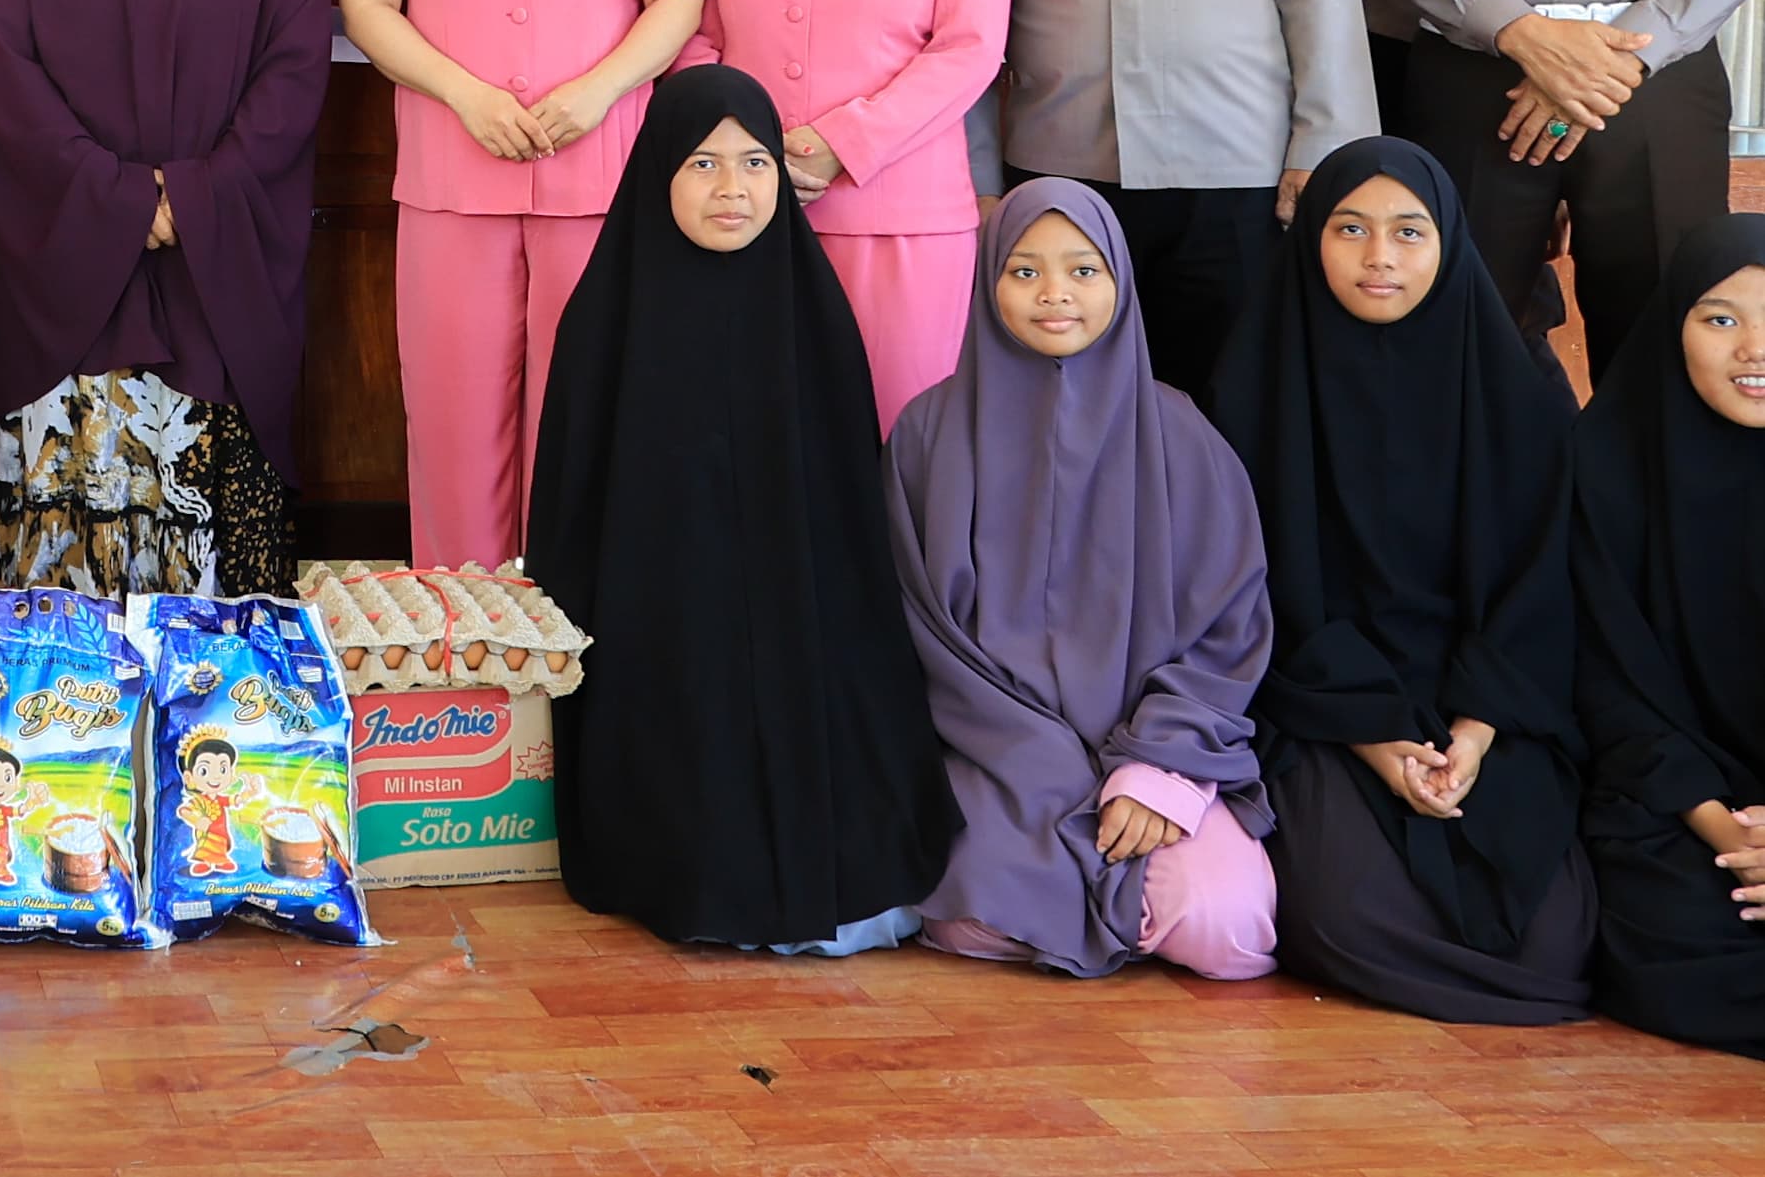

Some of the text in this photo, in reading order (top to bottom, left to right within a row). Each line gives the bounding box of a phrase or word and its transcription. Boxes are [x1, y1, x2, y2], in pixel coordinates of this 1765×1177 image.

[57, 677, 121, 704] Putri
[15, 690, 125, 738] Bugis
[384, 776, 463, 794] Mi Instan
[422, 806, 452, 818] Rasa
[400, 813, 536, 847] Soto Mie
